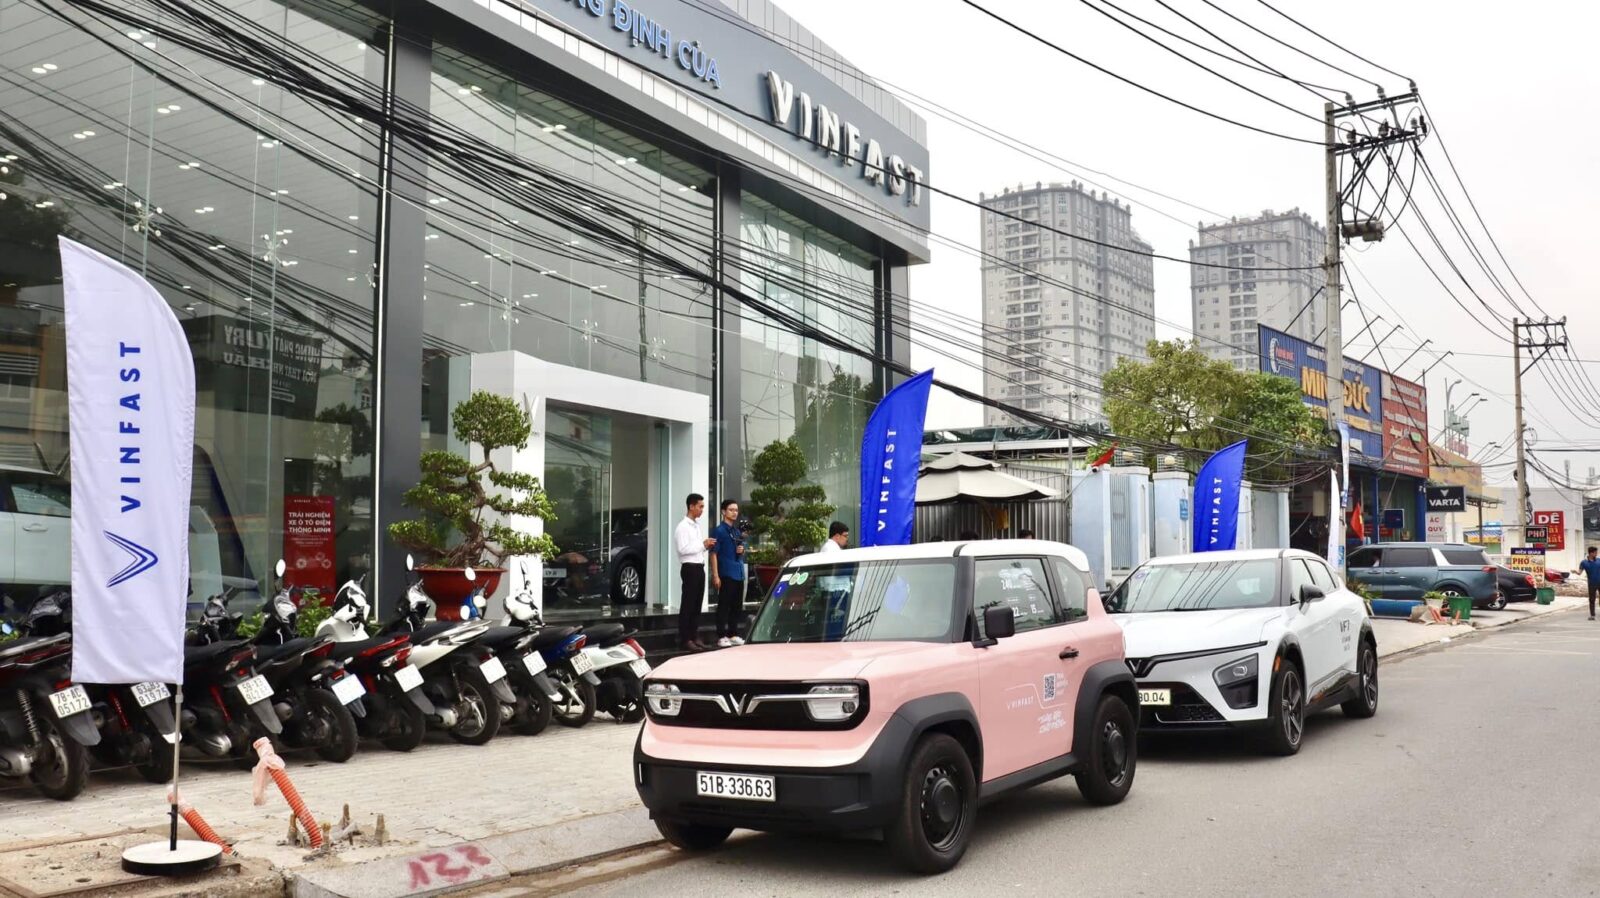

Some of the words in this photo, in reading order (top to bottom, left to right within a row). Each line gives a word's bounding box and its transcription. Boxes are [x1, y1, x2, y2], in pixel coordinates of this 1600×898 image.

[612, 0, 672, 59] ĐỊNH
[677, 39, 721, 89] CỦA
[766, 69, 924, 208] VINFAST
[119, 341, 142, 513] VINFAST
[878, 429, 897, 531] VINFAST
[1210, 478, 1222, 544] VINFAST
[1429, 498, 1461, 507] VARTA
[1538, 513, 1560, 524] DÊ
[700, 775, 772, 798] 51B-336.63
